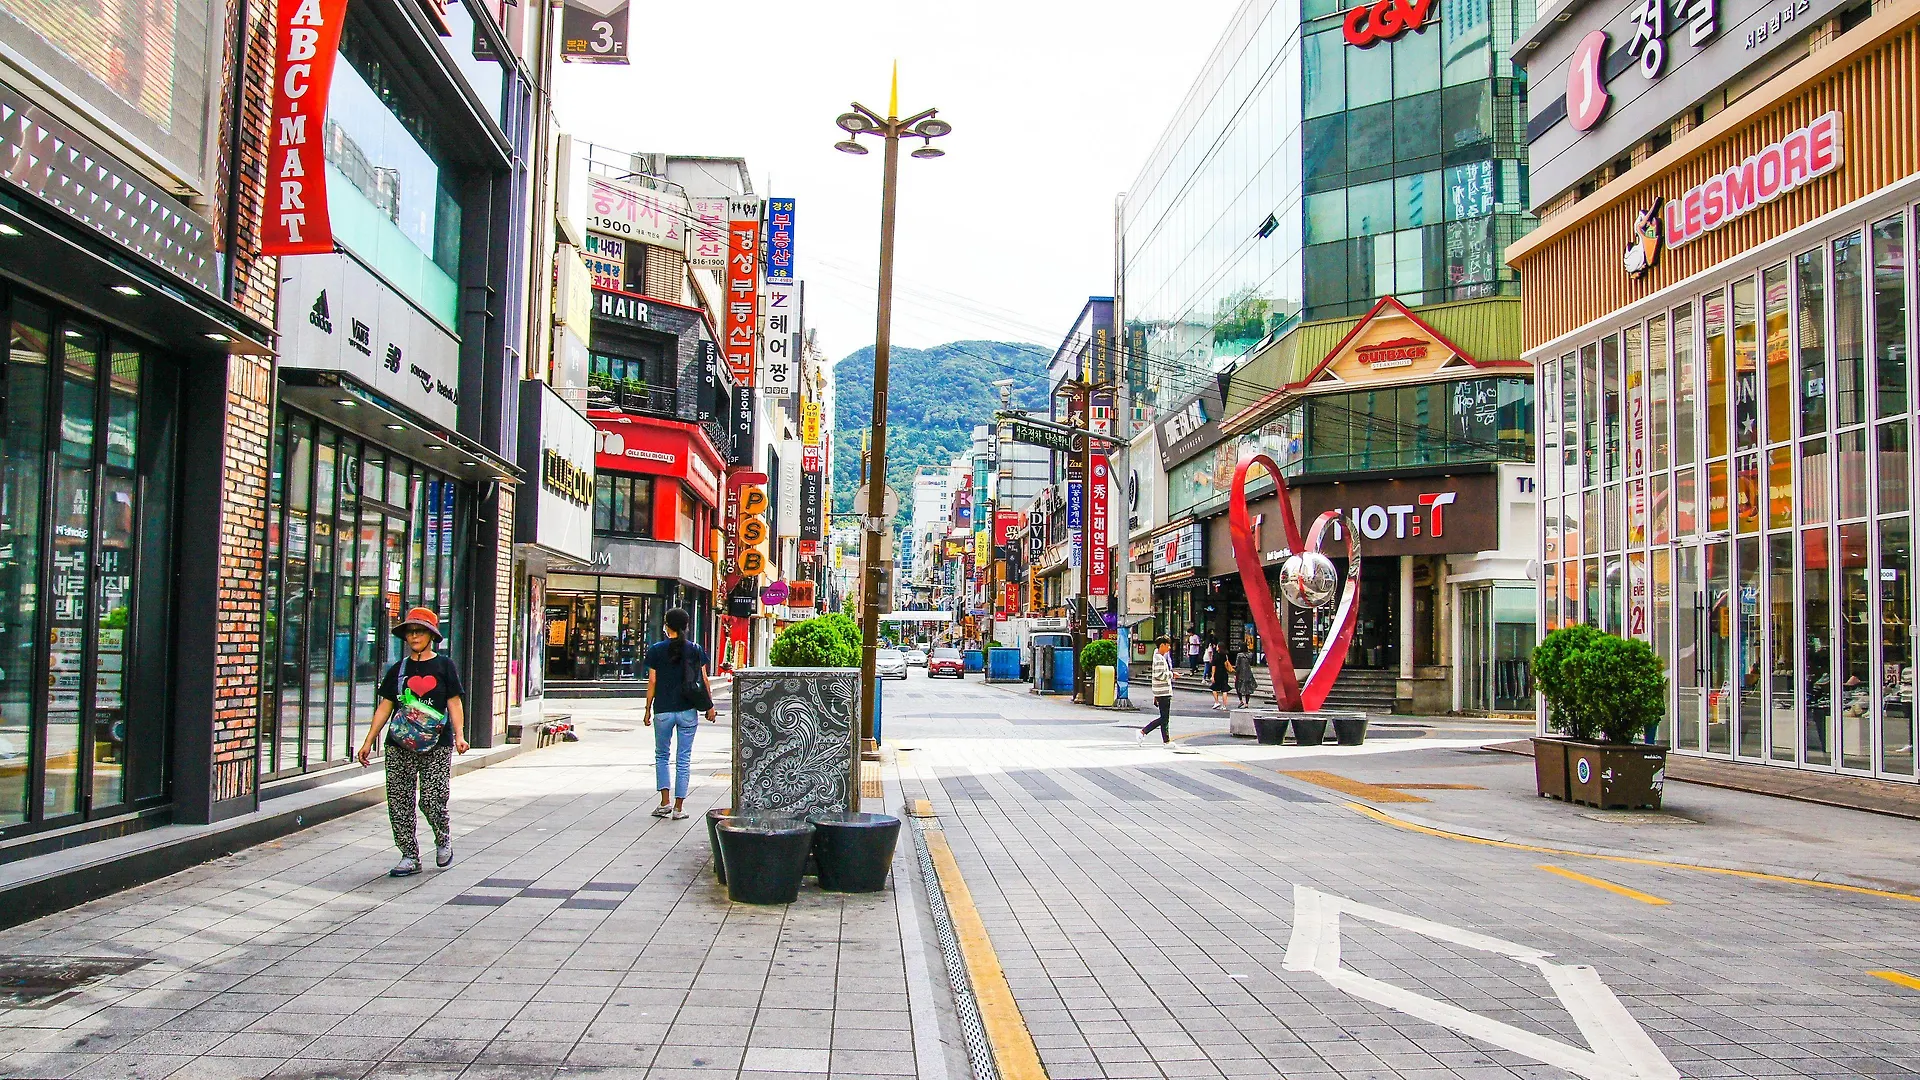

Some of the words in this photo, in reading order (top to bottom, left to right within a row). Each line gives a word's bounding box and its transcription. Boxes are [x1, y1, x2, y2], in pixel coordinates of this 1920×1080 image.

[1343, 0, 1431, 46] CGV
[566, 39, 587, 52] 본관
[1667, 118, 1832, 245] LESMORE
[696, 202, 724, 212] 한국
[695, 213, 723, 257] 부동산
[771, 213, 792, 267] 부동산
[692, 258, 725, 266] 816-1900
[601, 294, 649, 323] HAIR
[351, 317, 371, 346] VANS
[767, 315, 789, 383] 헤어짱
[1358, 346, 1428, 365] OUTBACK
[698, 411, 710, 421] 3F
[726, 488, 737, 574] 노래연습장
[1030, 512, 1043, 550] DVD
[1007, 586, 1018, 611] 사격장
